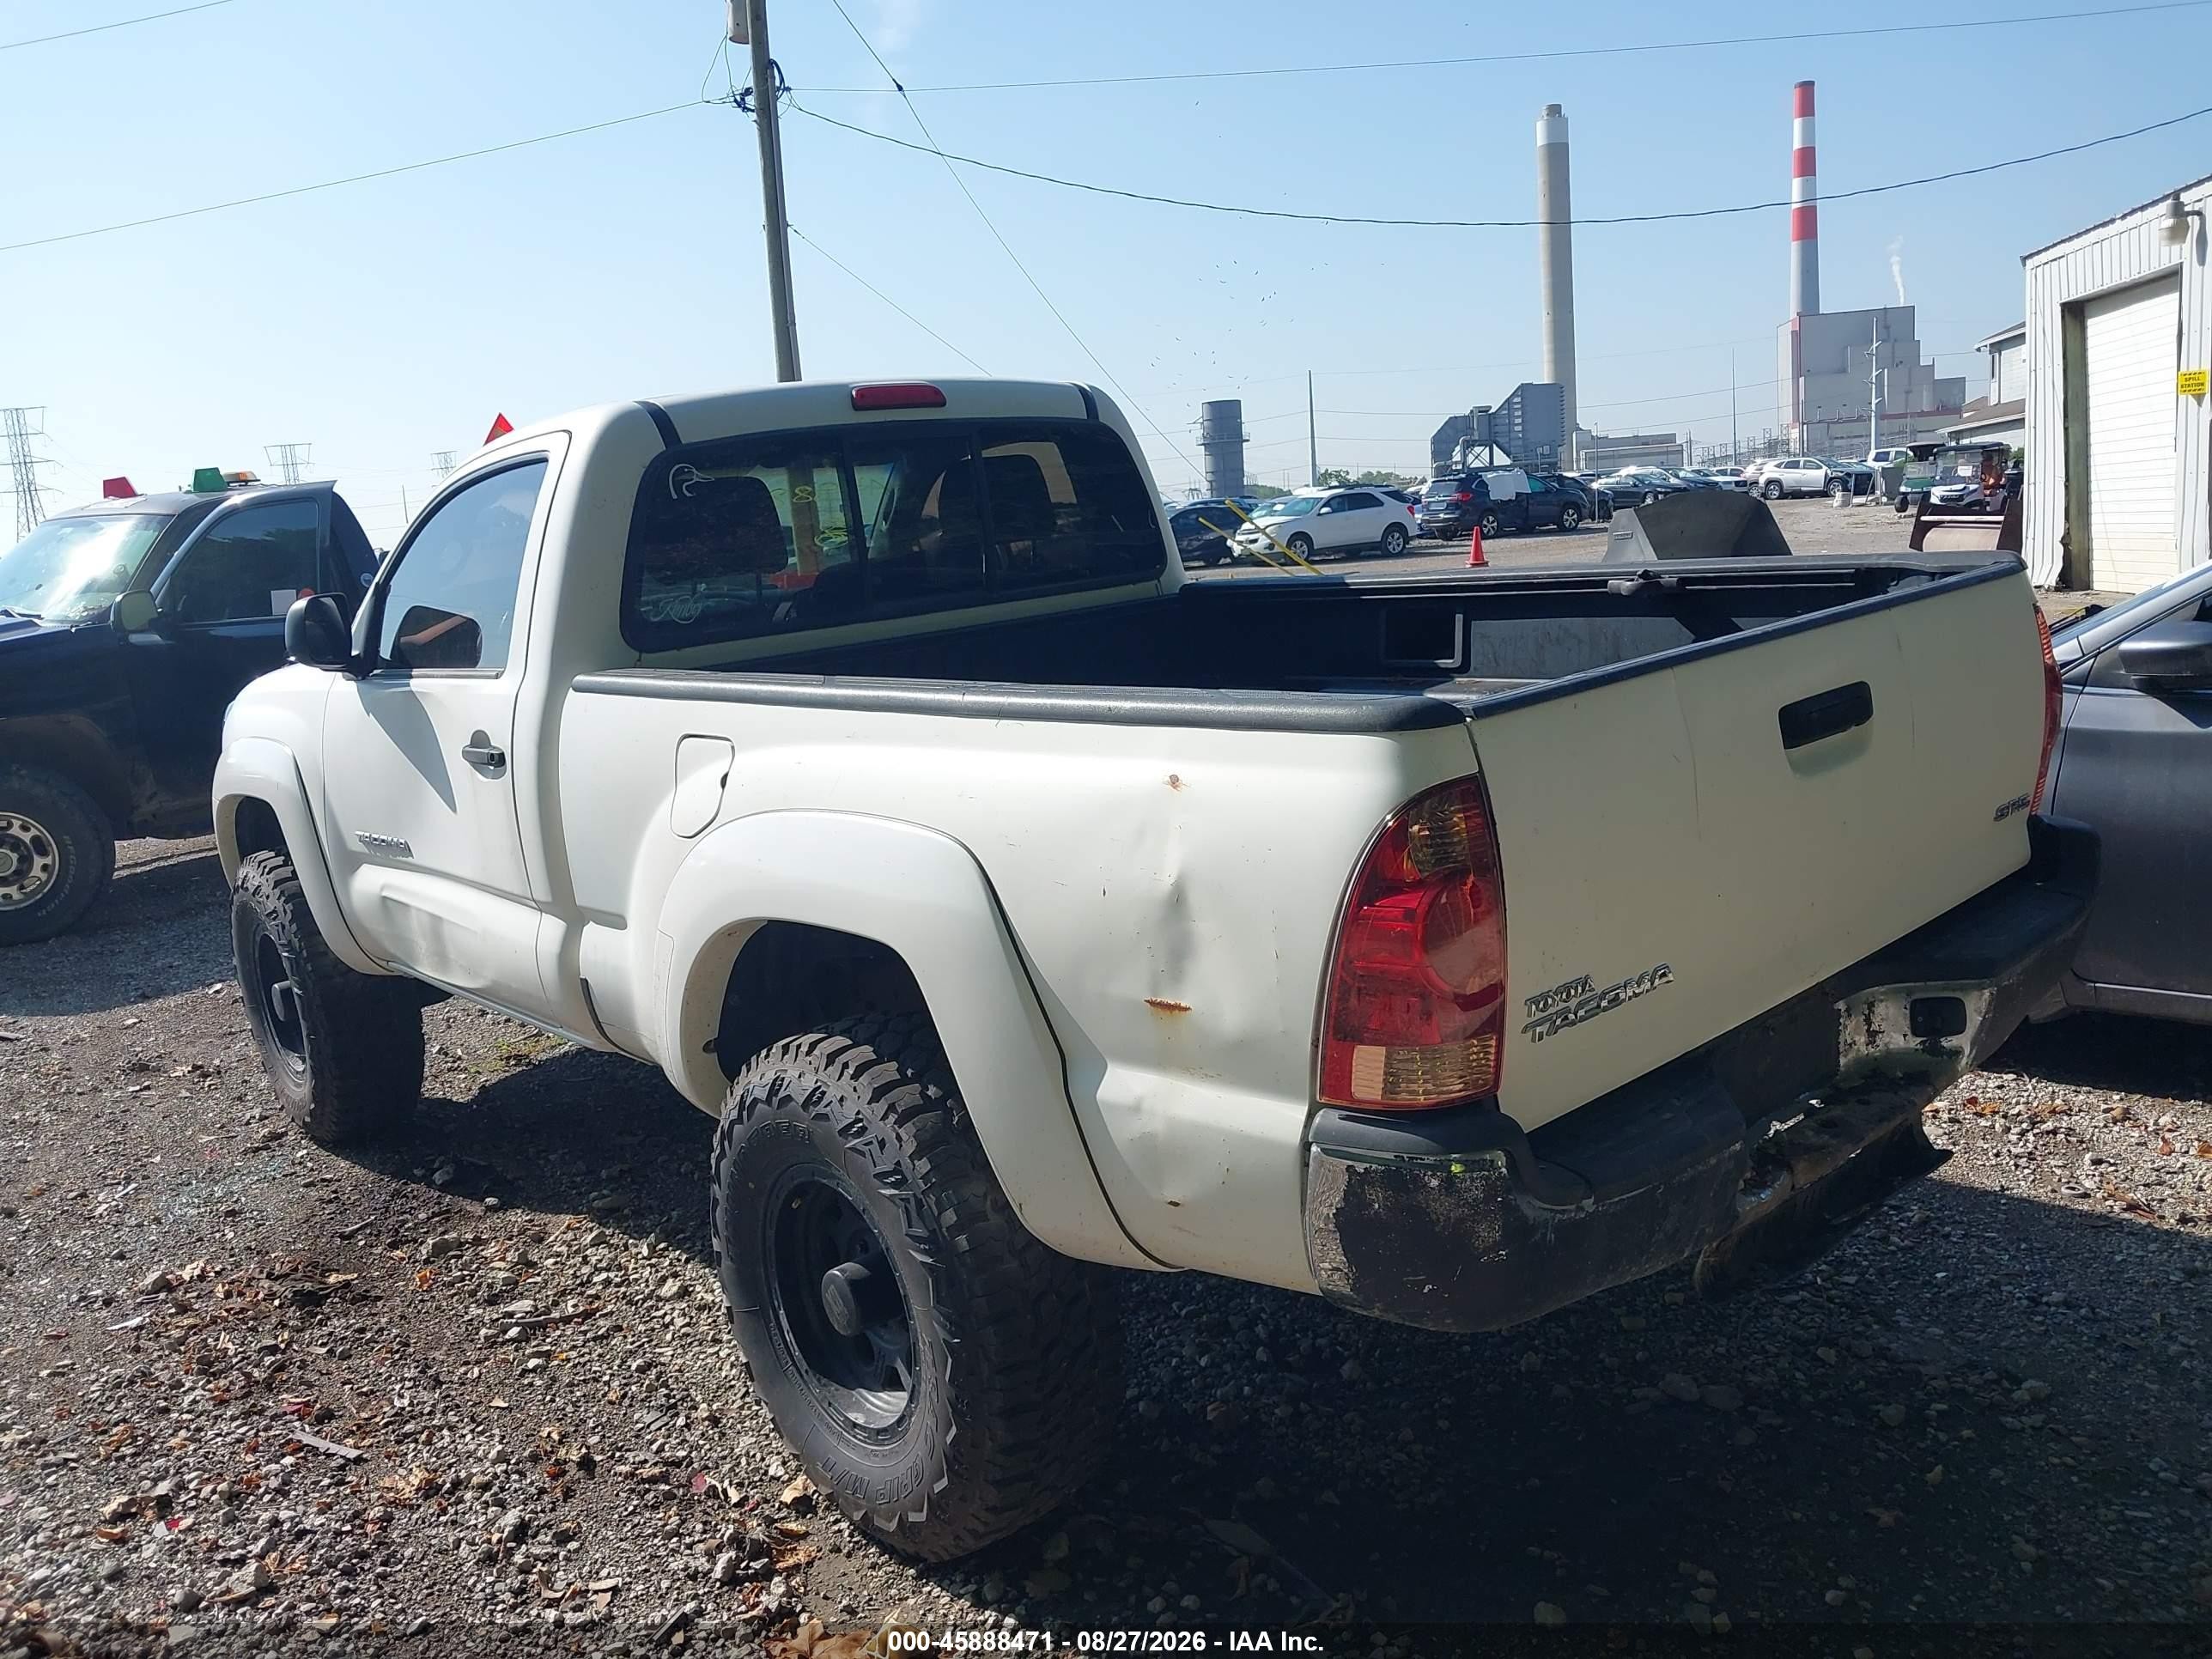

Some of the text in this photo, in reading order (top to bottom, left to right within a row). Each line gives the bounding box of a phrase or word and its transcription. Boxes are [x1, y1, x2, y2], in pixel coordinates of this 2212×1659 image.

[1521, 962, 1674, 1044] TACOMA
[1524, 974, 1596, 1018] TOYOTA
[817, 1456, 871, 1499] M/T
[875, 1453, 925, 1504] GRIP
